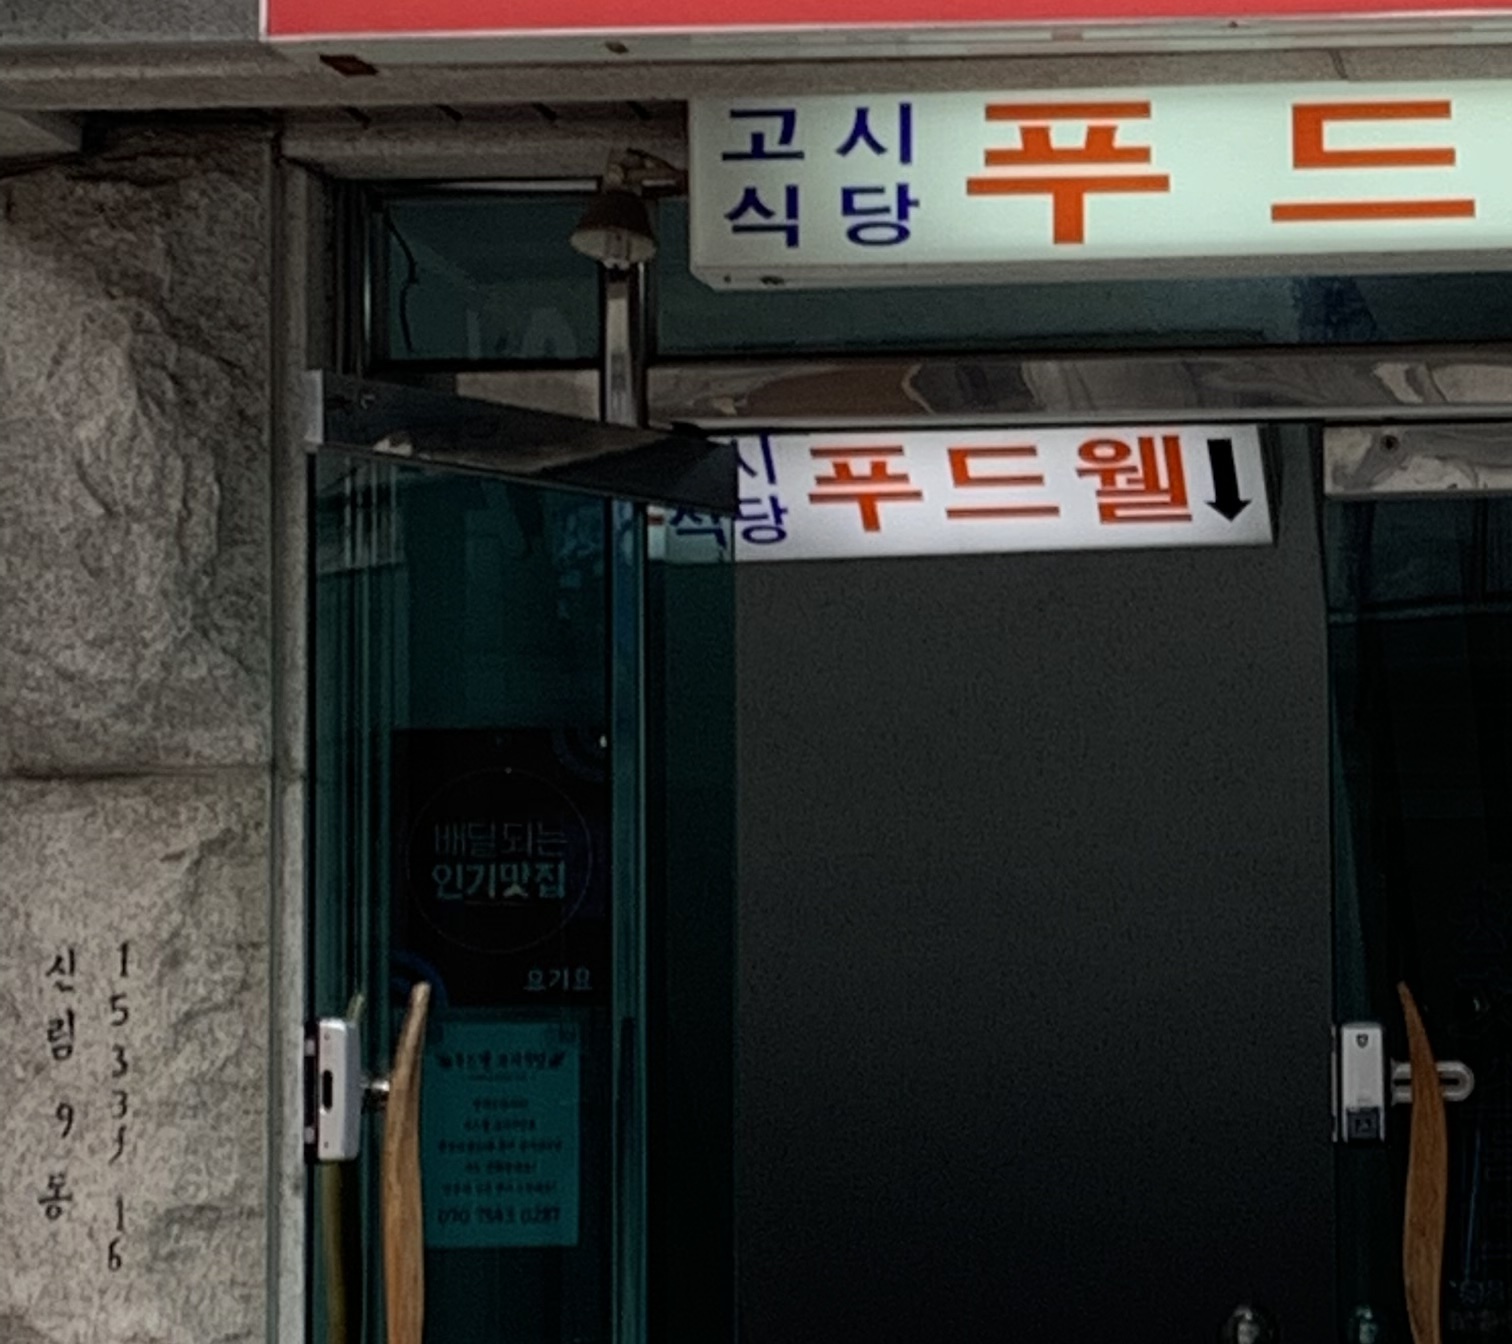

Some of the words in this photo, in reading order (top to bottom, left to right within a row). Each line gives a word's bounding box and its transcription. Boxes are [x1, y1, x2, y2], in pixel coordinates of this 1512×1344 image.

[722, 102, 912, 165] 고시
[723, 182, 920, 248] 식당
[808, 435, 1192, 532] 푸드웰
[431, 862, 567, 900] 인기맛집
[523, 965, 593, 993] 요기요
